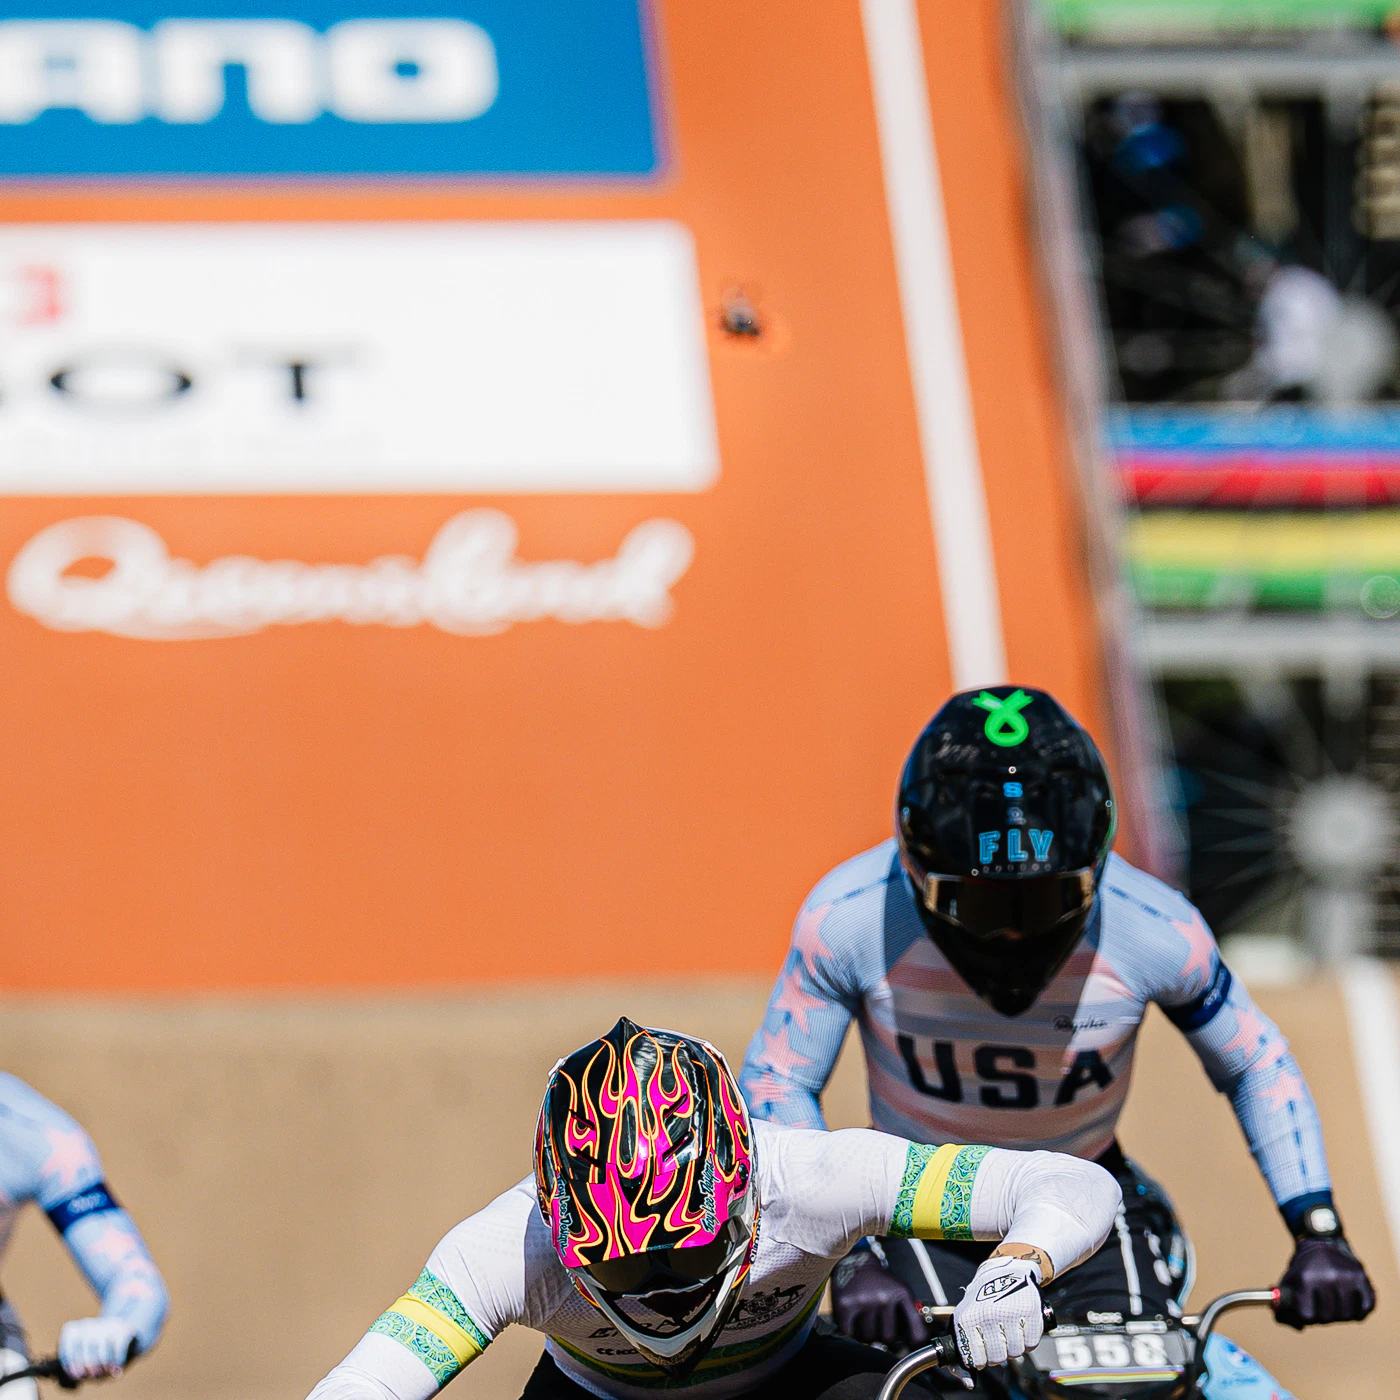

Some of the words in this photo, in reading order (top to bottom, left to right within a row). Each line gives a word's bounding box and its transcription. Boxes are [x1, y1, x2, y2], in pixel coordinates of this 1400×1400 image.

[6, 509, 694, 640] Queensland
[978, 828, 1054, 864] FLY
[897, 1032, 1114, 1110] USA
